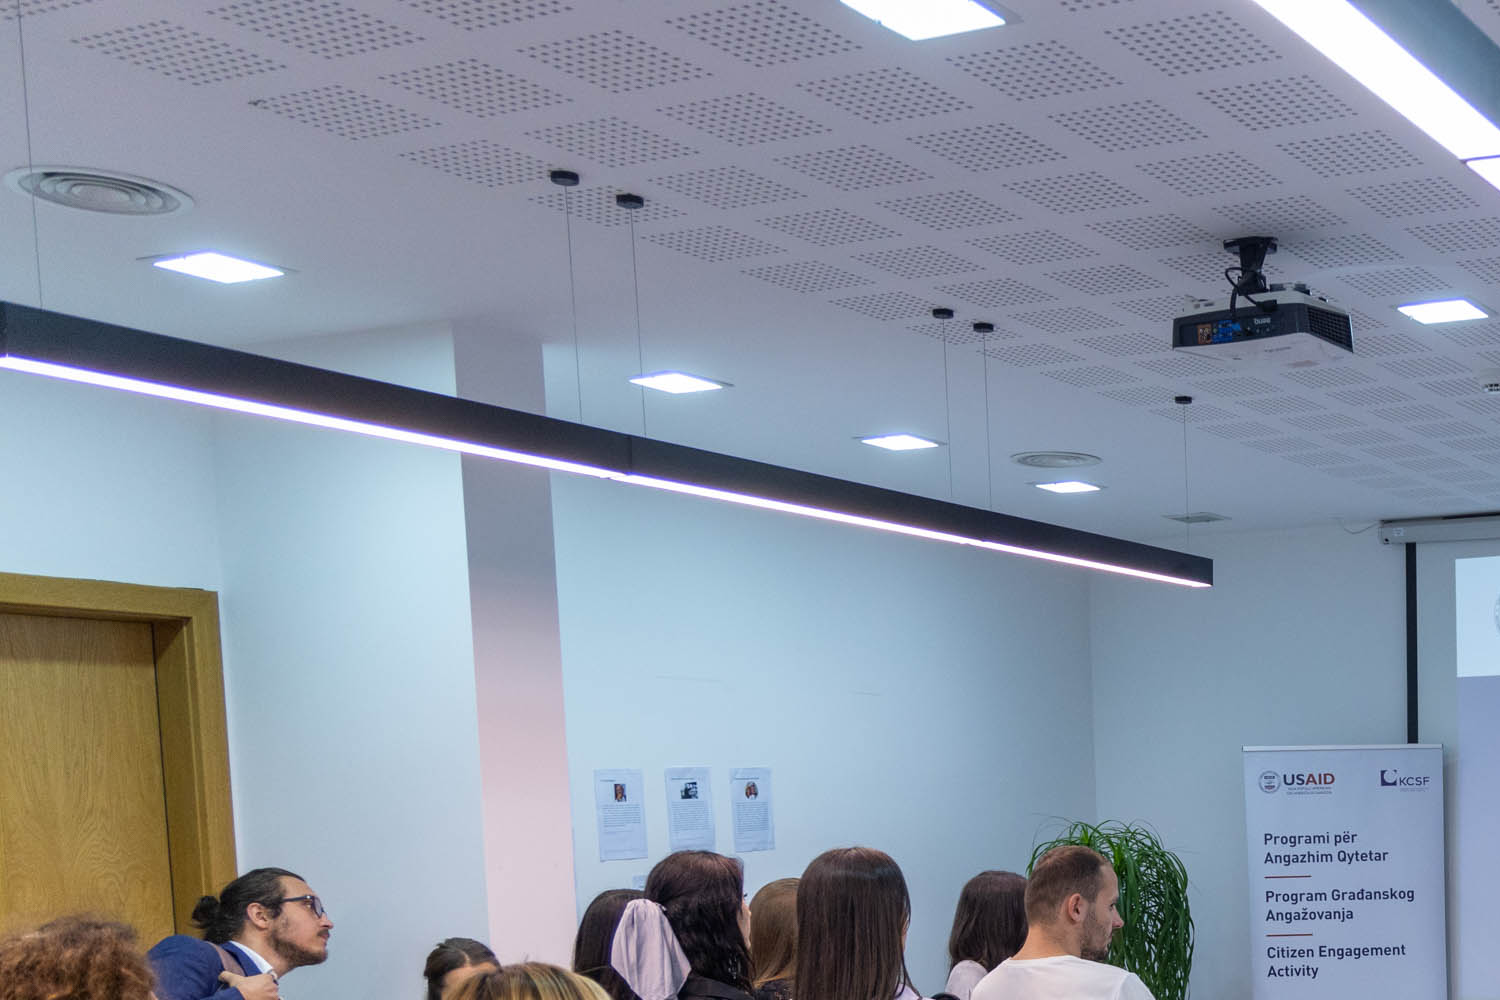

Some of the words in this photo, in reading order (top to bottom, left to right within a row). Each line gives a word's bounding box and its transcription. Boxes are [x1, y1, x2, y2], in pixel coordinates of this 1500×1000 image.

[1283, 773, 1335, 786] USAID
[1399, 776, 1430, 786] KCSF
[1264, 832, 1330, 847] Programi
[1334, 831, 1358, 847] për
[1264, 851, 1333, 866] Angazhim
[1337, 850, 1389, 864] Qytetar
[1265, 890, 1327, 905] Program
[1331, 888, 1415, 902] Građanskog
[1265, 908, 1354, 924] Angažovanja
[1267, 946, 1315, 959] Citizen
[1318, 944, 1406, 960] Engagement
[1267, 964, 1319, 980] Activity
